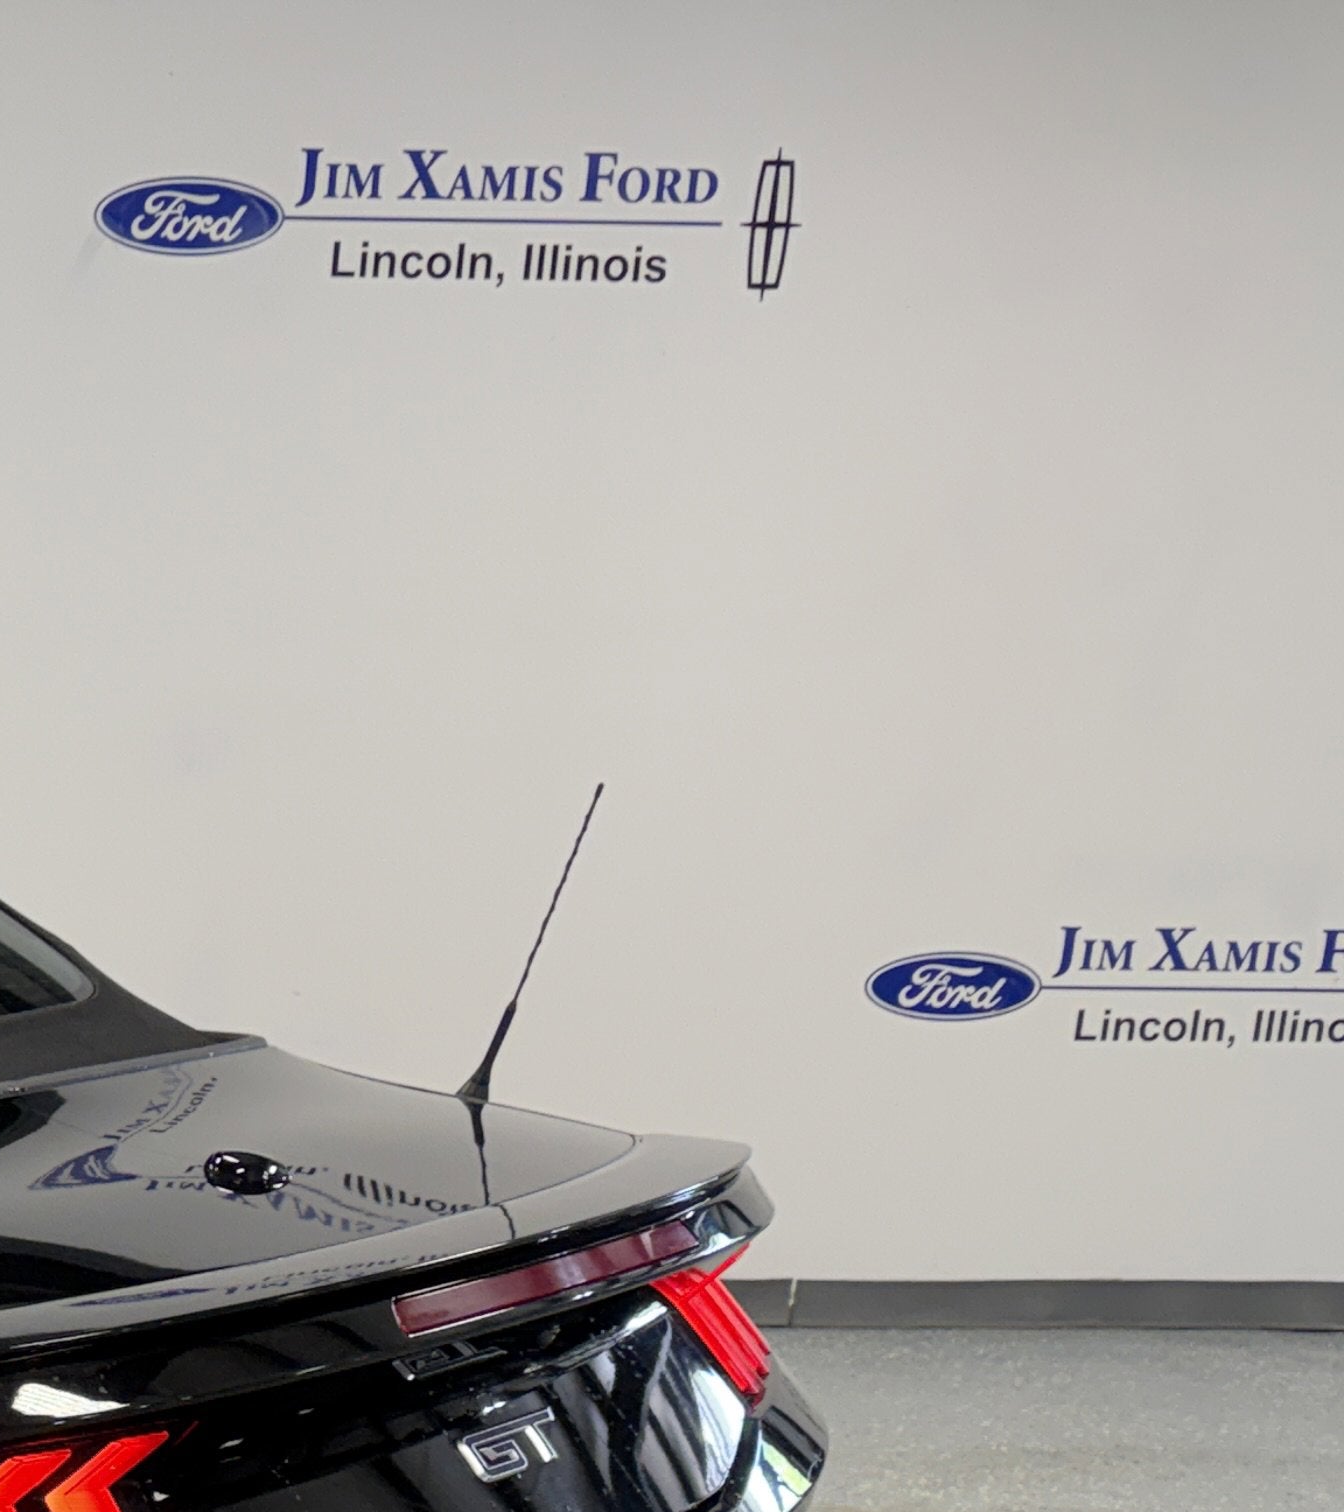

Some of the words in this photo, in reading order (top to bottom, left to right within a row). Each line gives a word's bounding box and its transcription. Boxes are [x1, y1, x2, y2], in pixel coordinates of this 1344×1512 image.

[294, 147, 385, 208] JIM
[397, 149, 564, 202] XAMIS
[579, 151, 719, 204] FORD
[129, 189, 248, 243] Ford
[330, 240, 505, 287] Lincoln,
[522, 243, 667, 283] Illinois
[1052, 925, 1138, 979] JIM
[1147, 926, 1303, 974] XAMIS
[897, 962, 1007, 1010] Ford
[1073, 1008, 1236, 1049] Lincoln,
[457, 1406, 558, 1483] GT
